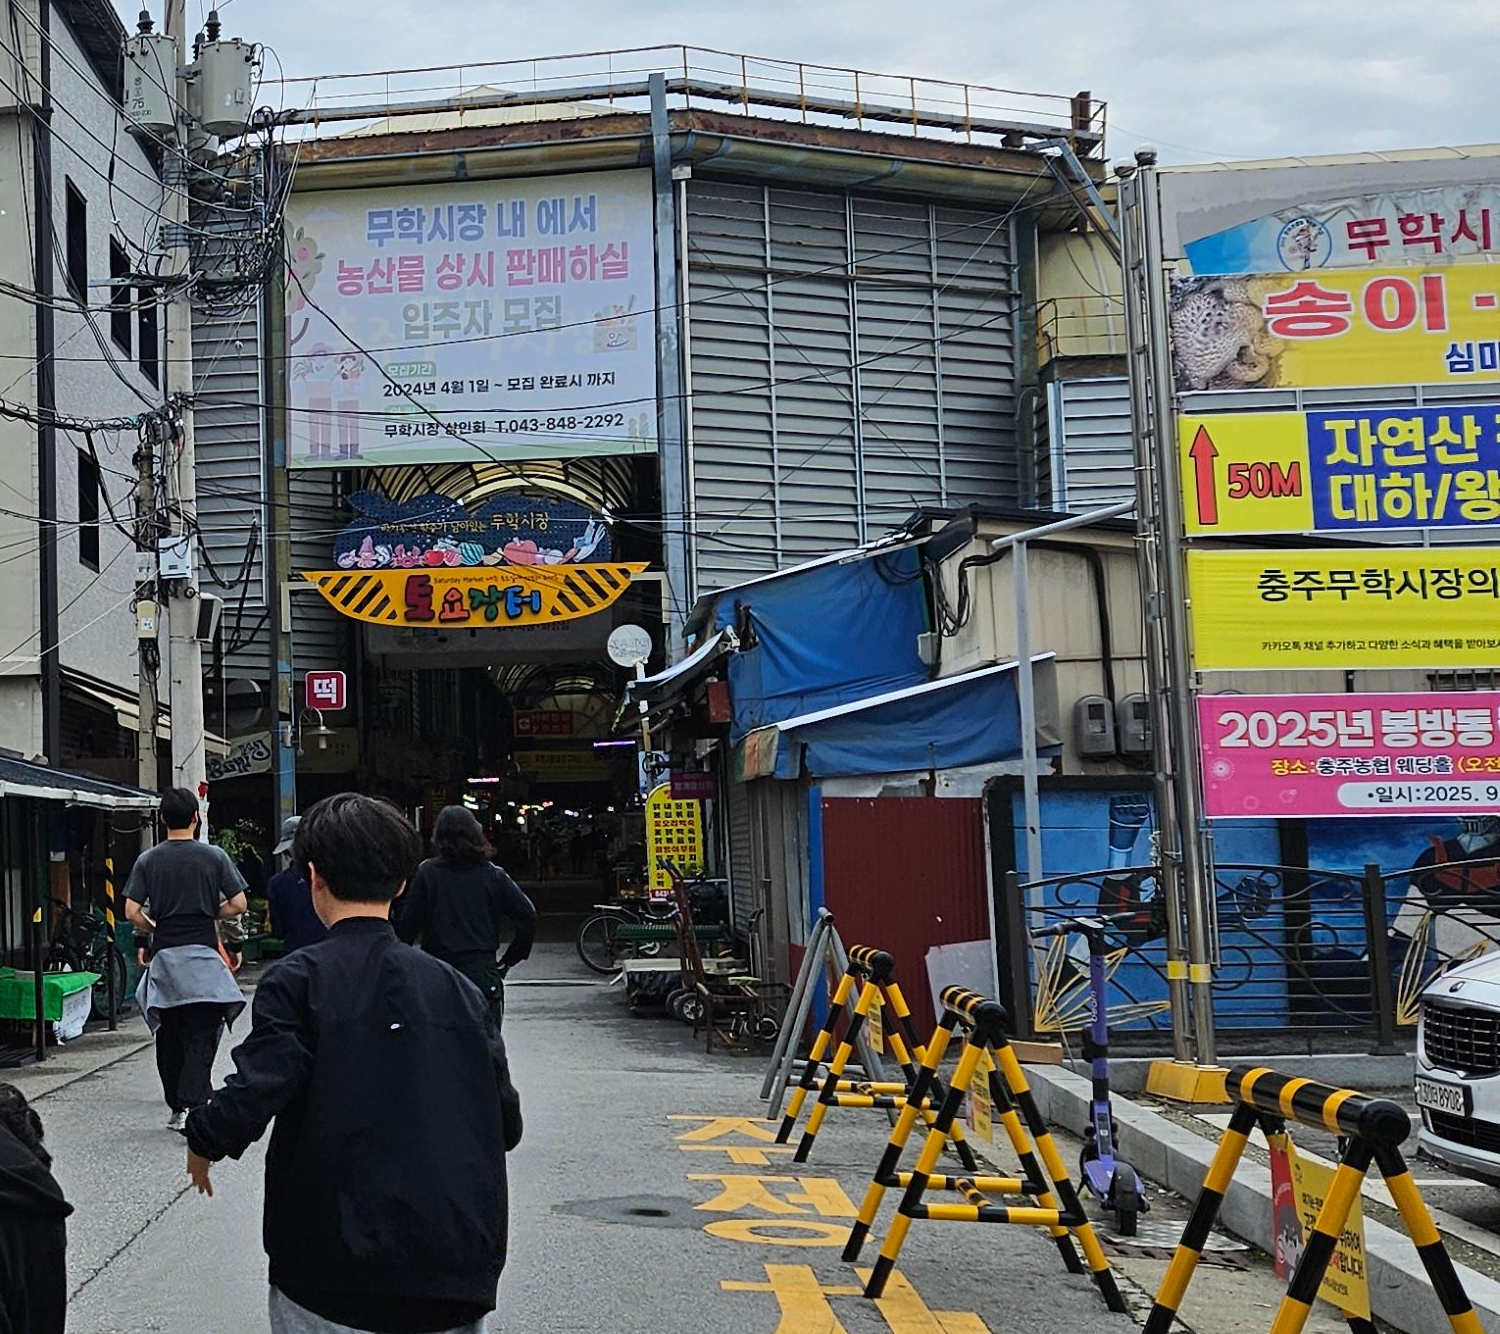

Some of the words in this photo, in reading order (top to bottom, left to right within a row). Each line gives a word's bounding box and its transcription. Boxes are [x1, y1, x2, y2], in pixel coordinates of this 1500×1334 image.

[367, 203, 487, 247] 무학시장
[497, 200, 525, 238] 내
[536, 195, 597, 236] 에서
[337, 254, 426, 296] 농산물
[436, 250, 495, 291] 상시
[506, 241, 630, 288] 판매하실
[402, 299, 494, 341] 입주자
[503, 295, 563, 335] 모집
[1265, 275, 1447, 337] 송이
[383, 383, 436, 397] 2024년
[441, 380, 464, 395] 4월
[469, 379, 489, 393] 1일
[507, 378, 534, 392] 모집
[540, 375, 582, 389] 완료시
[587, 372, 615, 386] 까지
[387, 365, 433, 377] 모집기간
[384, 422, 440, 438] 무학시장
[445, 420, 486, 436] 상인회
[1324, 415, 1481, 467] 자연산
[1228, 462, 1301, 499] 50M
[404, 574, 542, 623] 토요장터
[1256, 567, 1500, 602] 충주무학시장의
[1261, 641, 1301, 652] 카카오톡
[1303, 641, 1324, 651] 채널
[1326, 640, 1366, 651] 추가하고
[1368, 639, 1398, 650] 다양한
[1401, 639, 1431, 650] 소식과
[313, 677, 337, 704] 떡
[1217, 709, 1375, 748] 2025년
[1381, 708, 1494, 748] 봉방동
[1396, 755, 1453, 774] 웨딩홀
